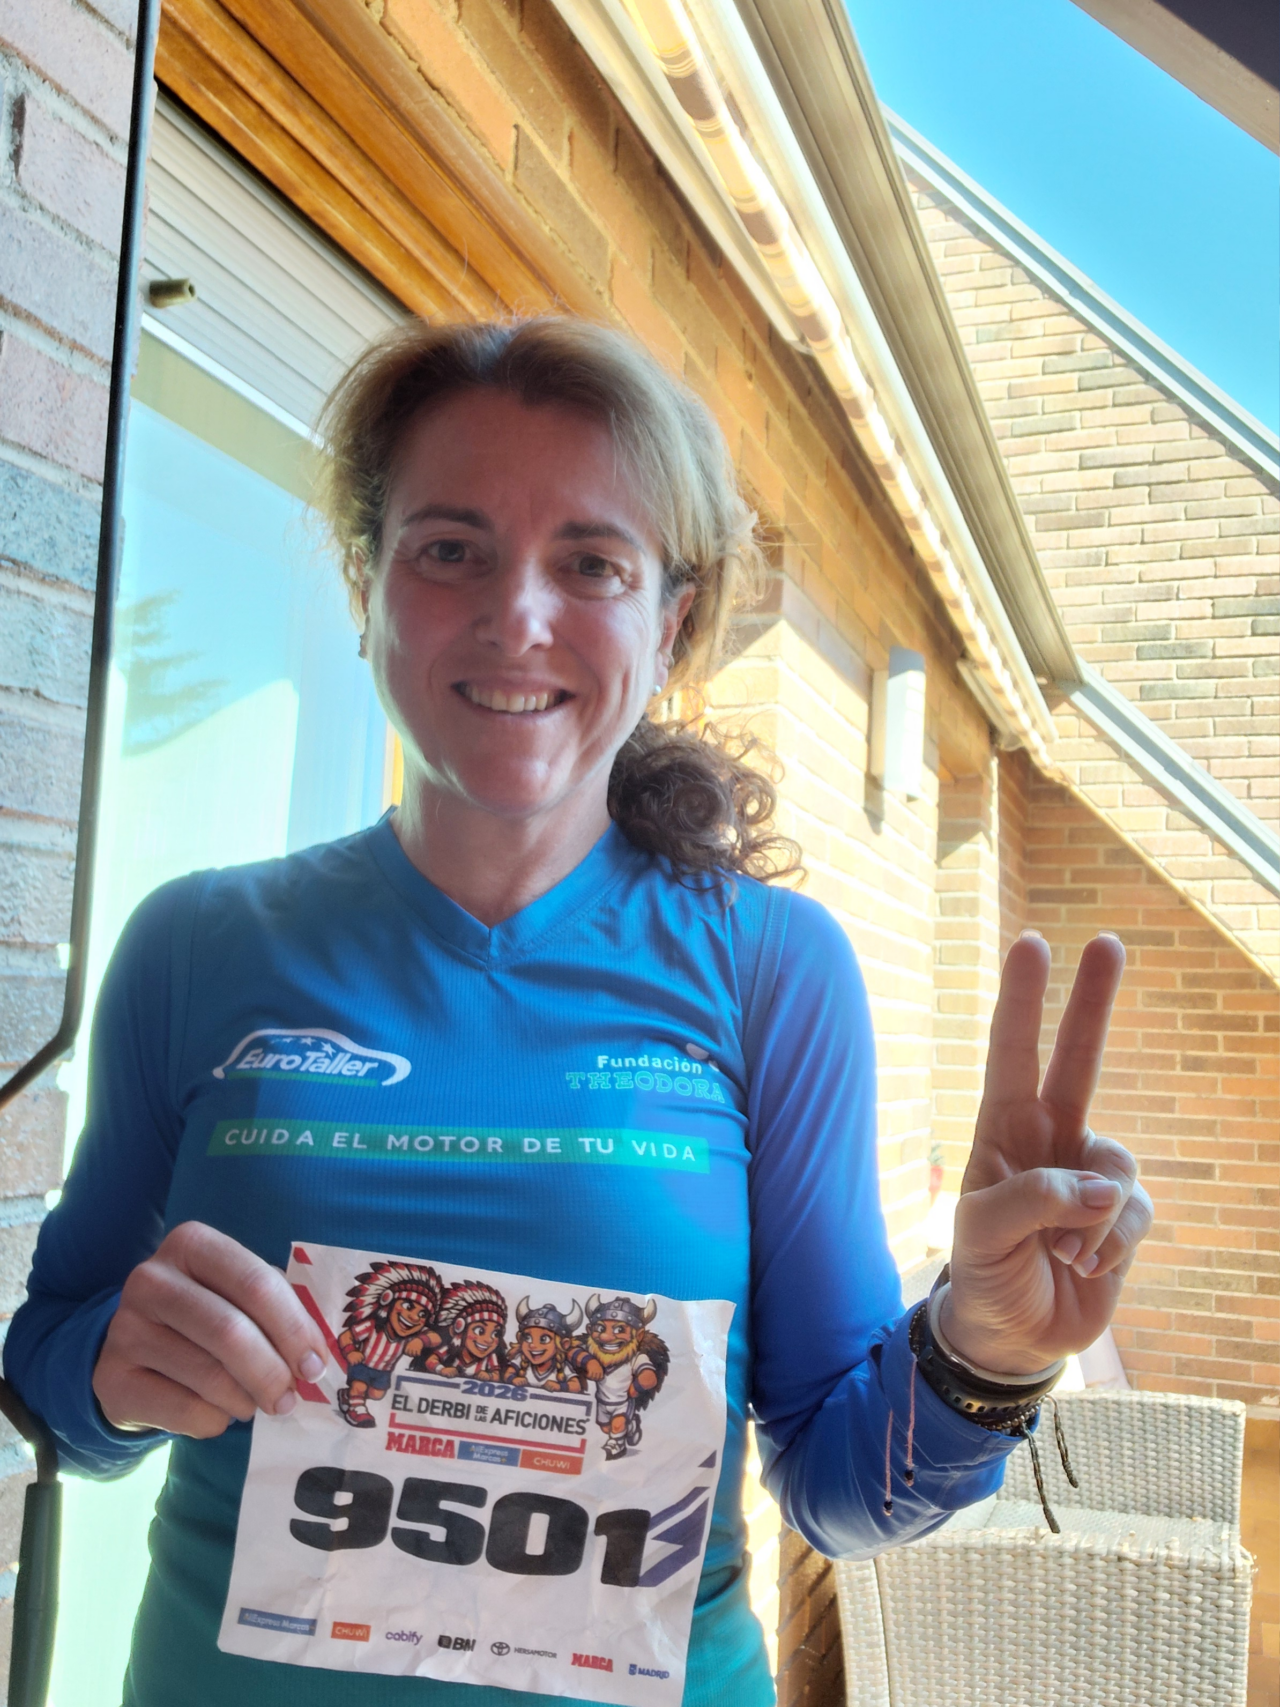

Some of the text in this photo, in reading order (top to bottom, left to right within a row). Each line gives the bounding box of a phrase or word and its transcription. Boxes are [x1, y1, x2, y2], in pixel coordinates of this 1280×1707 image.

[239, 1047, 379, 1078] EuroTaller
[598, 1055, 702, 1074] Fundación
[565, 1071, 725, 1103] THEODORA
[224, 1128, 696, 1162] CUIDA EL MOTOR DE TU VIDA
[461, 1380, 529, 1402] 2026
[390, 1394, 586, 1436] EL DERBI DE AFICIONES
[474, 1414, 487, 1423] LAS
[385, 1431, 456, 1459] MARCA
[533, 1456, 570, 1469] CHUWI
[290, 1466, 651, 1587] 9501
[335, 1626, 368, 1638] CHUWI
[385, 1630, 423, 1646] cabify
[571, 1653, 613, 1672] MARCA
[638, 1667, 670, 1680] MADRID
